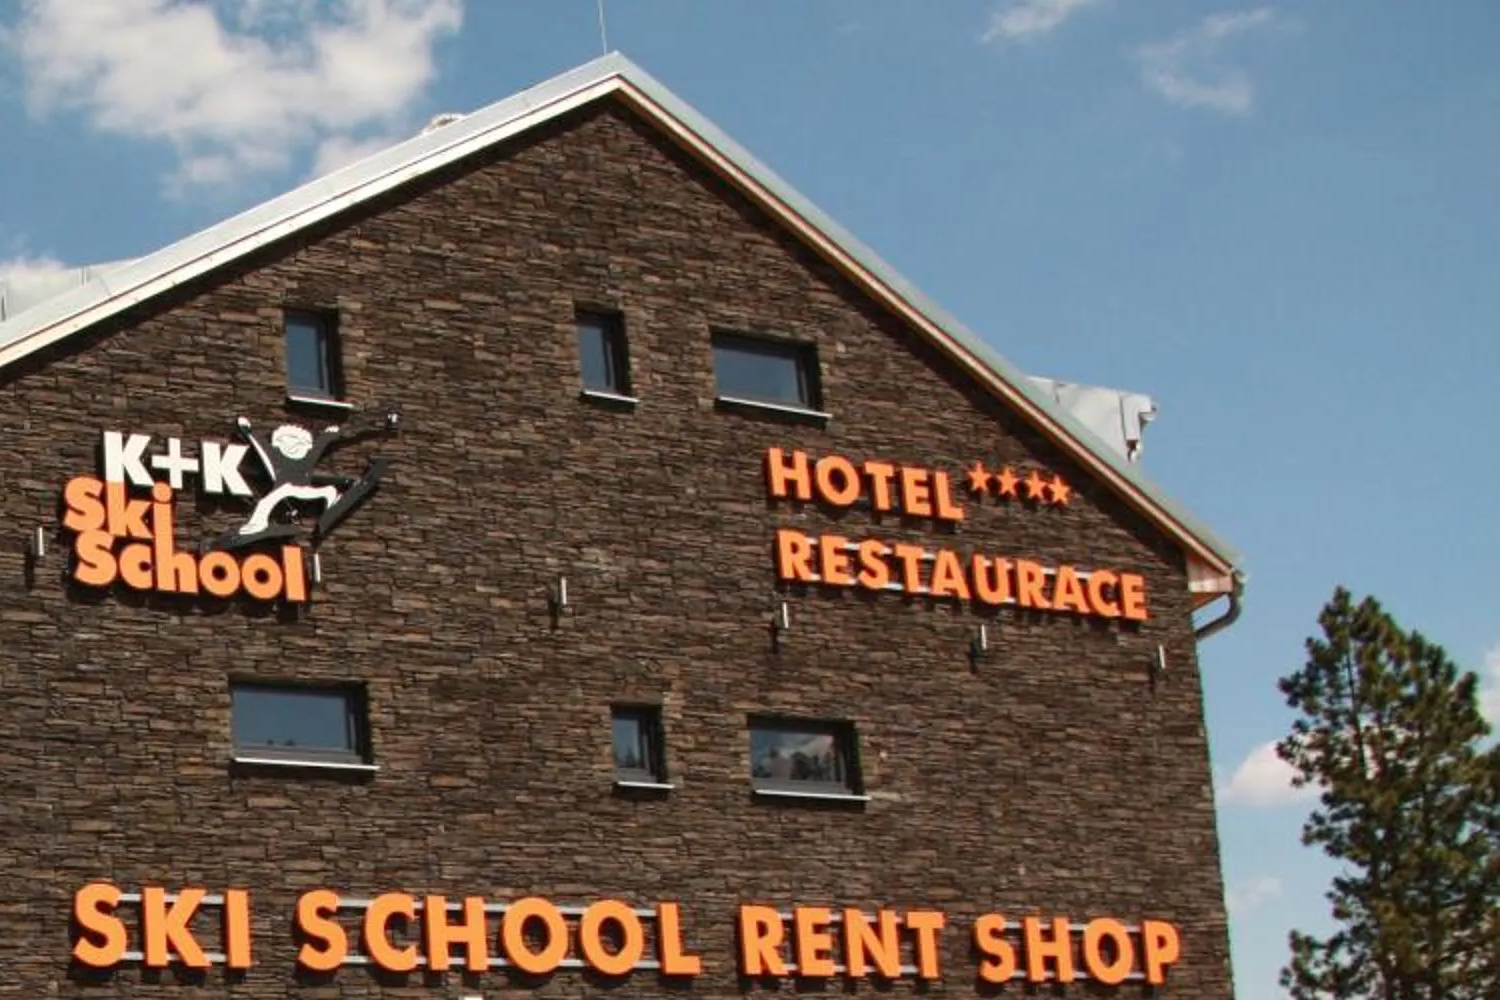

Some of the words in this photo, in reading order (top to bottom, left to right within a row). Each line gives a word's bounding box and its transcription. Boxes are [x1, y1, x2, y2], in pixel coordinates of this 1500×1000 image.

[103, 431, 253, 496] K+K
[766, 447, 965, 521] HOTEL
[63, 476, 174, 540] Ski
[73, 530, 306, 602] School
[775, 529, 1148, 621] RESTAURACE
[72, 883, 252, 969] SKI
[297, 889, 701, 976] SCHOOL
[738, 903, 946, 979] RENT
[974, 912, 1181, 986] SHOP
